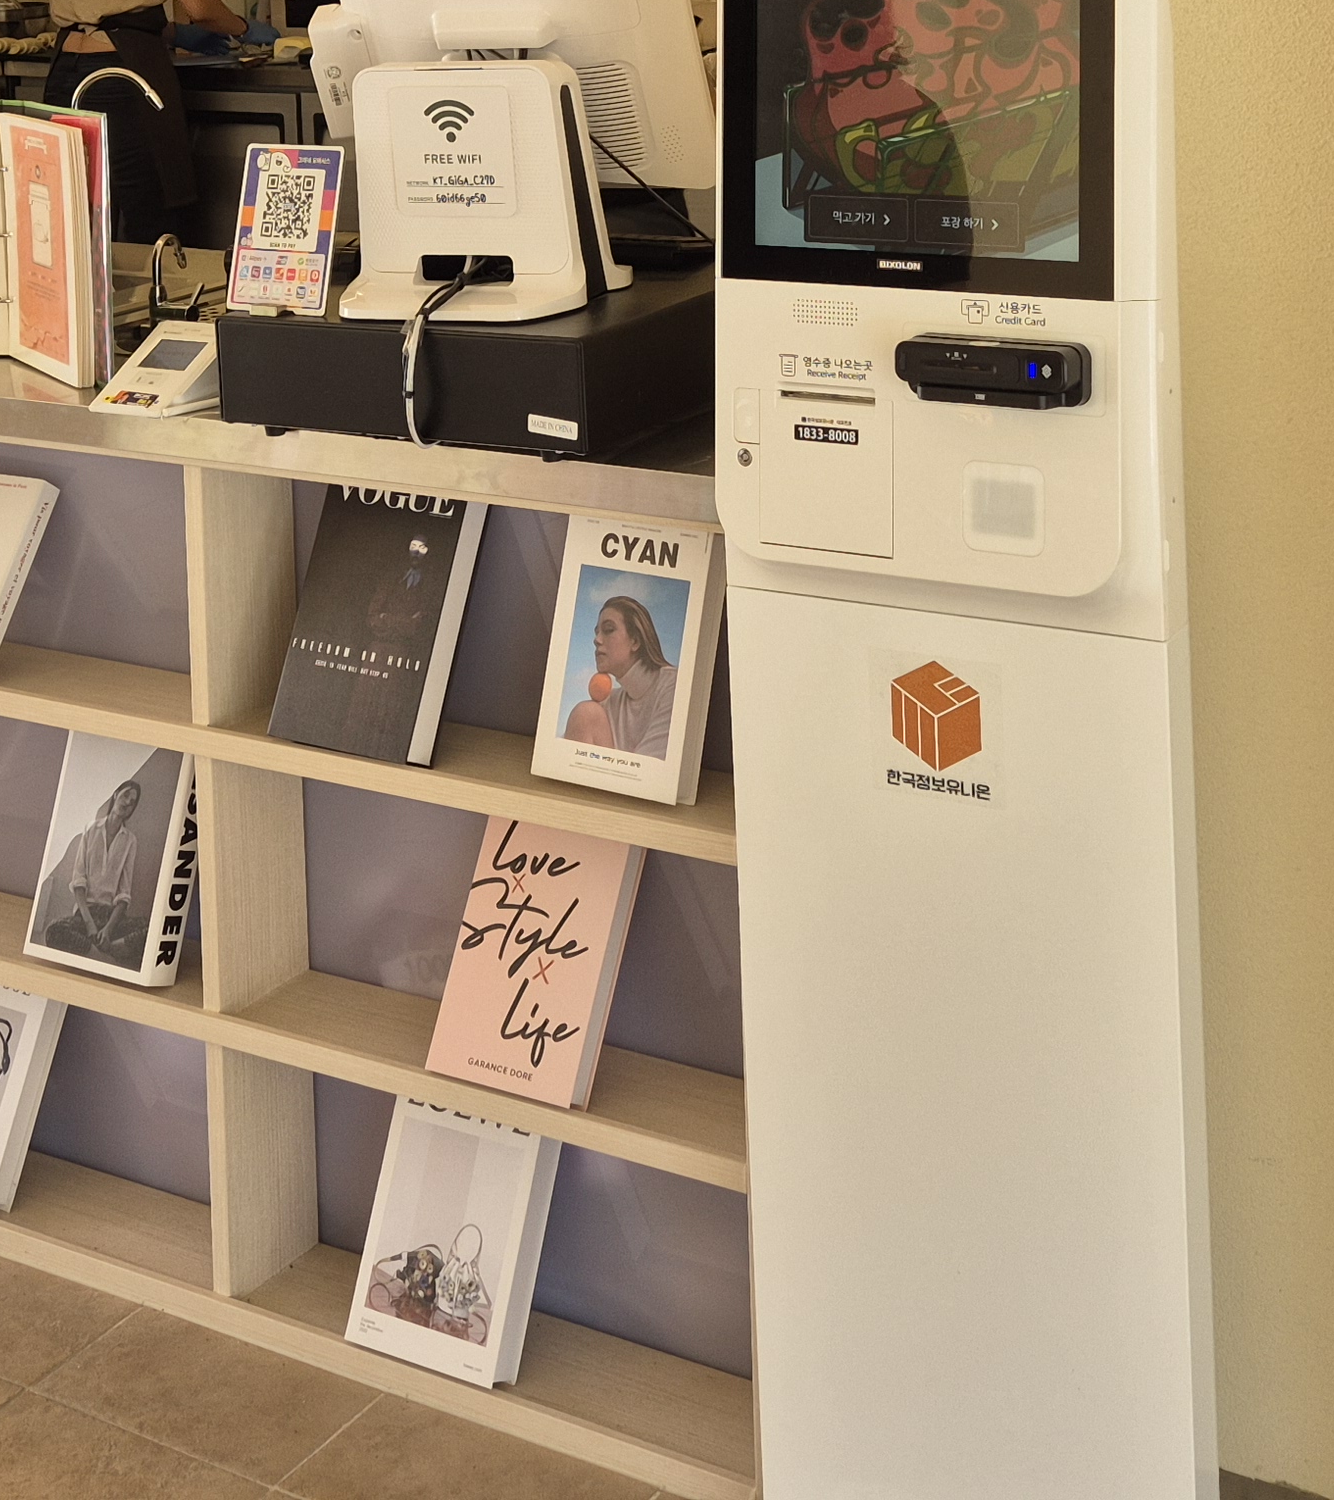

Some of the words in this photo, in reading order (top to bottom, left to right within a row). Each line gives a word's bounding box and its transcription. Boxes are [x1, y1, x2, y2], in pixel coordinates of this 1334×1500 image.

[424, 154, 454, 164] FREE
[457, 154, 482, 164] WIFI
[832, 211, 853, 224] 먹고
[854, 212, 875, 225] 가기
[940, 216, 960, 229] 포장
[963, 217, 984, 230] 하기
[879, 260, 921, 271] BIXOLON
[999, 302, 1043, 315] 신용카드
[995, 315, 1022, 326] Credit
[1024, 317, 1046, 327] Card
[803, 356, 831, 369] 영수증
[807, 369, 836, 379] Receive
[838, 371, 867, 382] Receipt
[531, 419, 546, 429] MADE
[547, 422, 554, 430] IN
[554, 424, 573, 434] CHINA
[798, 427, 856, 443] 1833-8008
[601, 532, 680, 569] CYAN
[574, 748, 588, 757] Just
[589, 752, 600, 760] the
[602, 756, 615, 764] way
[616, 758, 629, 766] you
[886, 768, 992, 802] 한국정보유니온
[467, 1056, 508, 1075] GARANCE
[510, 1068, 534, 1082] DORE
